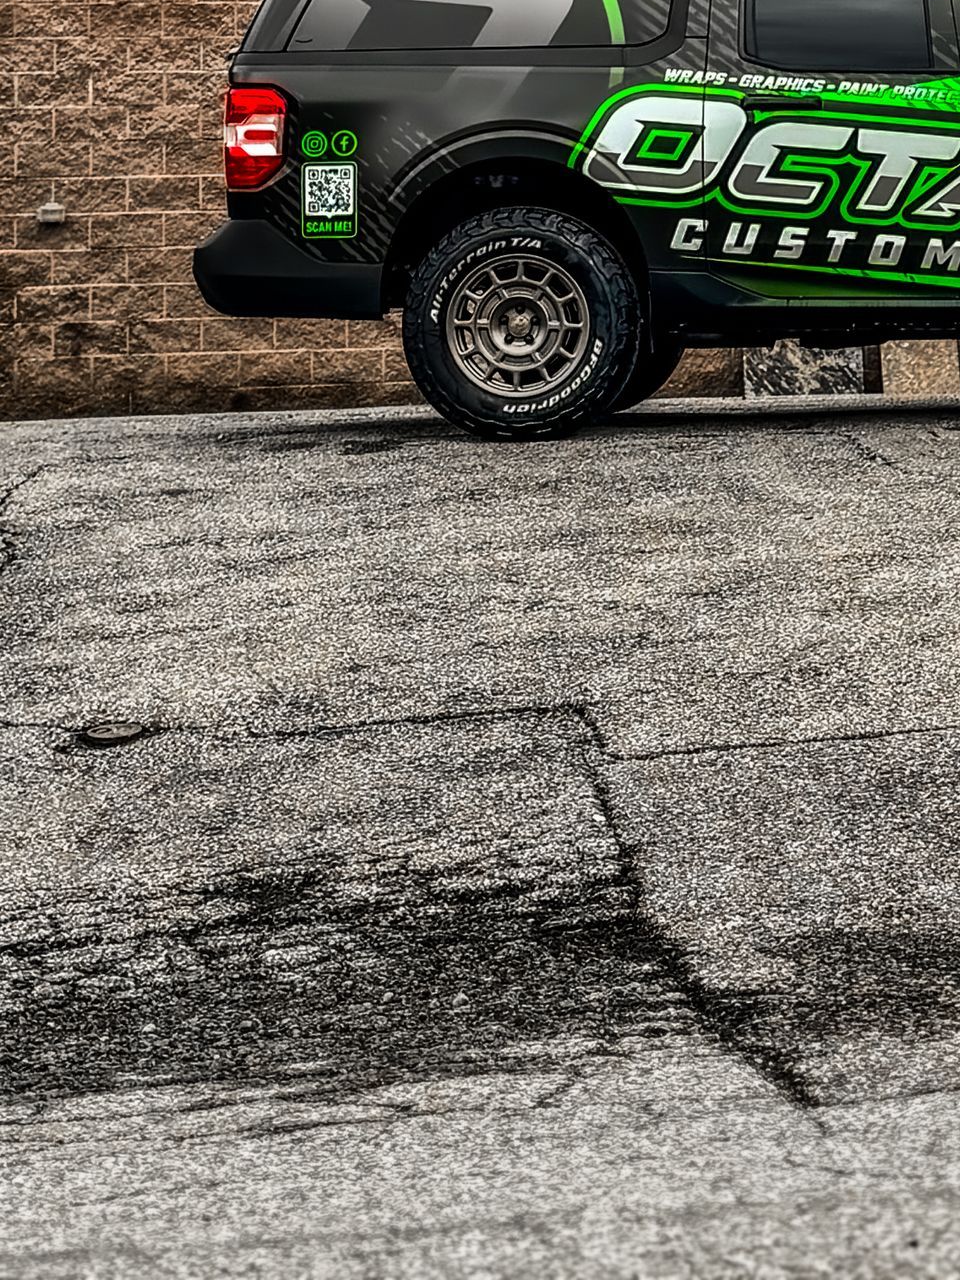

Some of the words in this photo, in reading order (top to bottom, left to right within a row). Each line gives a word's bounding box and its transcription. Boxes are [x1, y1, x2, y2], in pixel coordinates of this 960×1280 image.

[664, 68, 728, 86] WRAPS
[739, 74, 826, 93] GRAPHICS
[837, 81, 890, 98] PAINT
[306, 221, 332, 233] SCAN
[334, 221, 352, 232] ME!
[430, 240, 506, 324] All-Terrain
[510, 237, 542, 249] T/A
[503, 338, 603, 414] BFGoodrich
